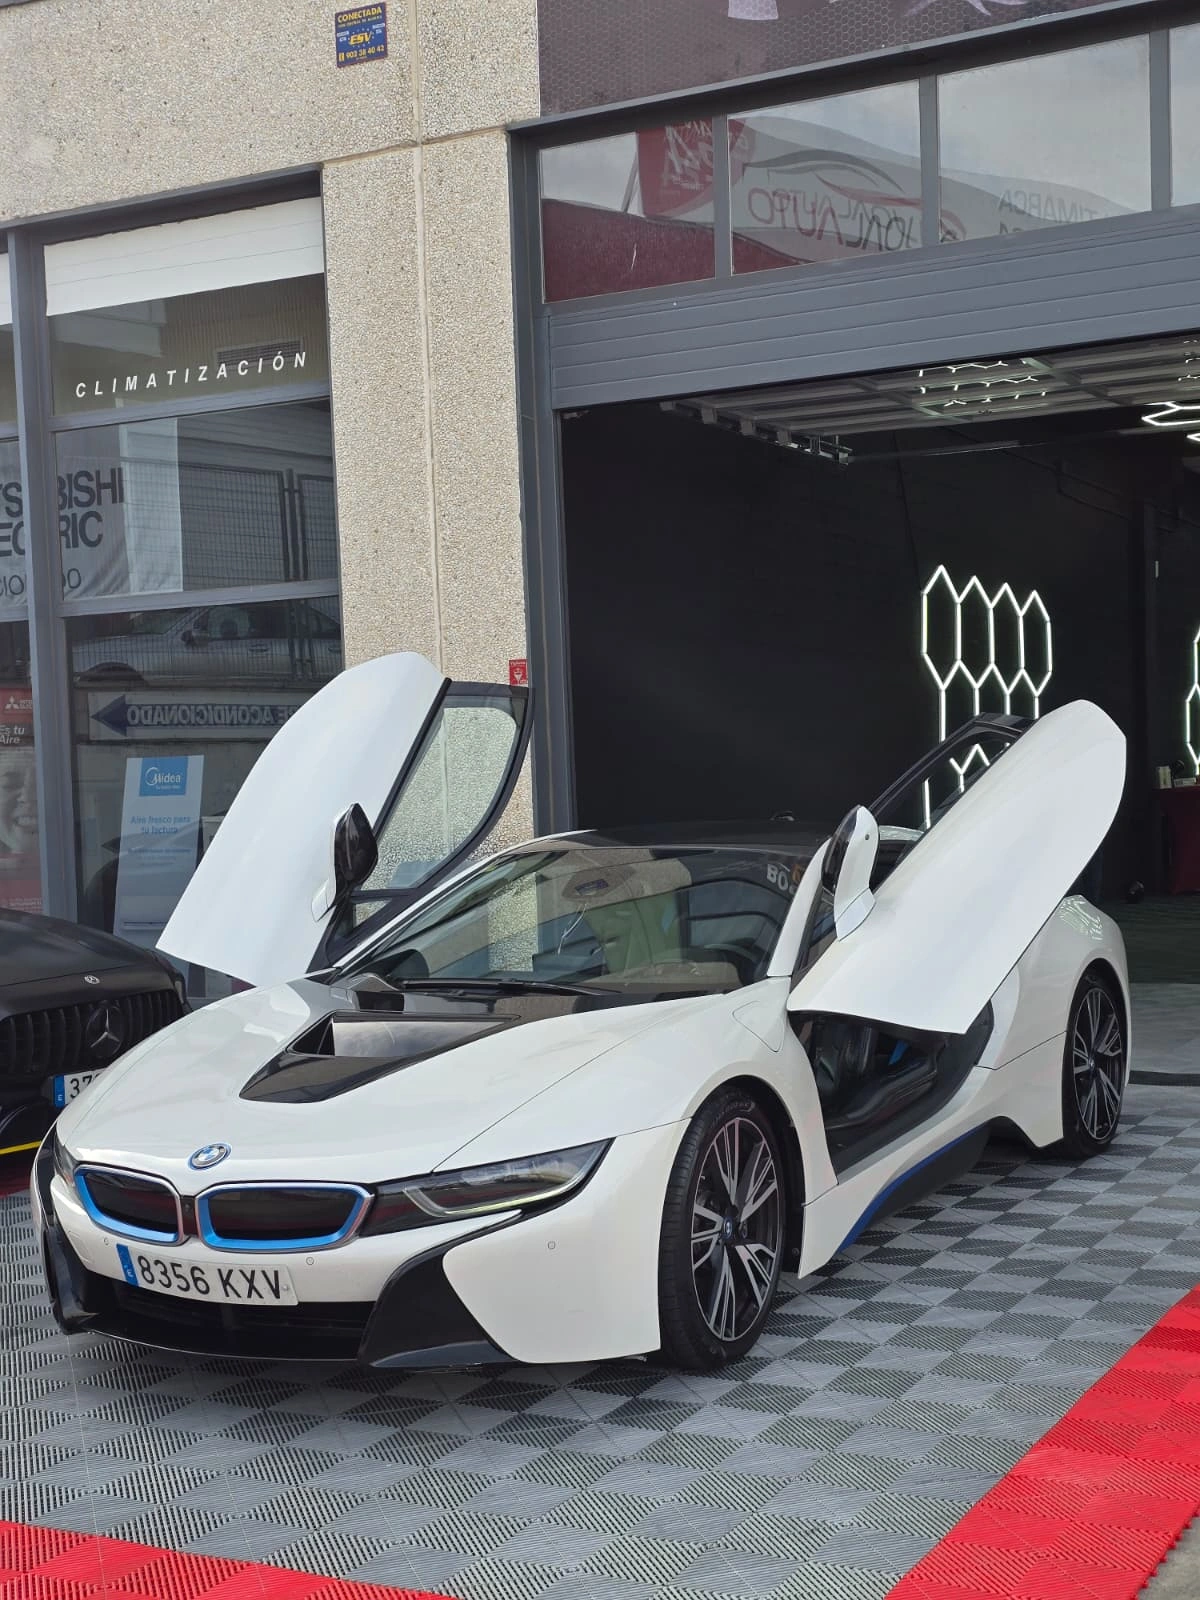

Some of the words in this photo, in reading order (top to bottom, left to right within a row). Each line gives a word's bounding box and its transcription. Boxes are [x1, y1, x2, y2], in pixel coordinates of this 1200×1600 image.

[337, 6, 382, 23] CONECTADA
[75, 351, 307, 398] CLIMATIZACIÓN
[147, 769, 181, 785] Midea
[70, 1073, 101, 1099] 37
[138, 1255, 210, 1295] 8356
[217, 1268, 281, 1299] KXV
